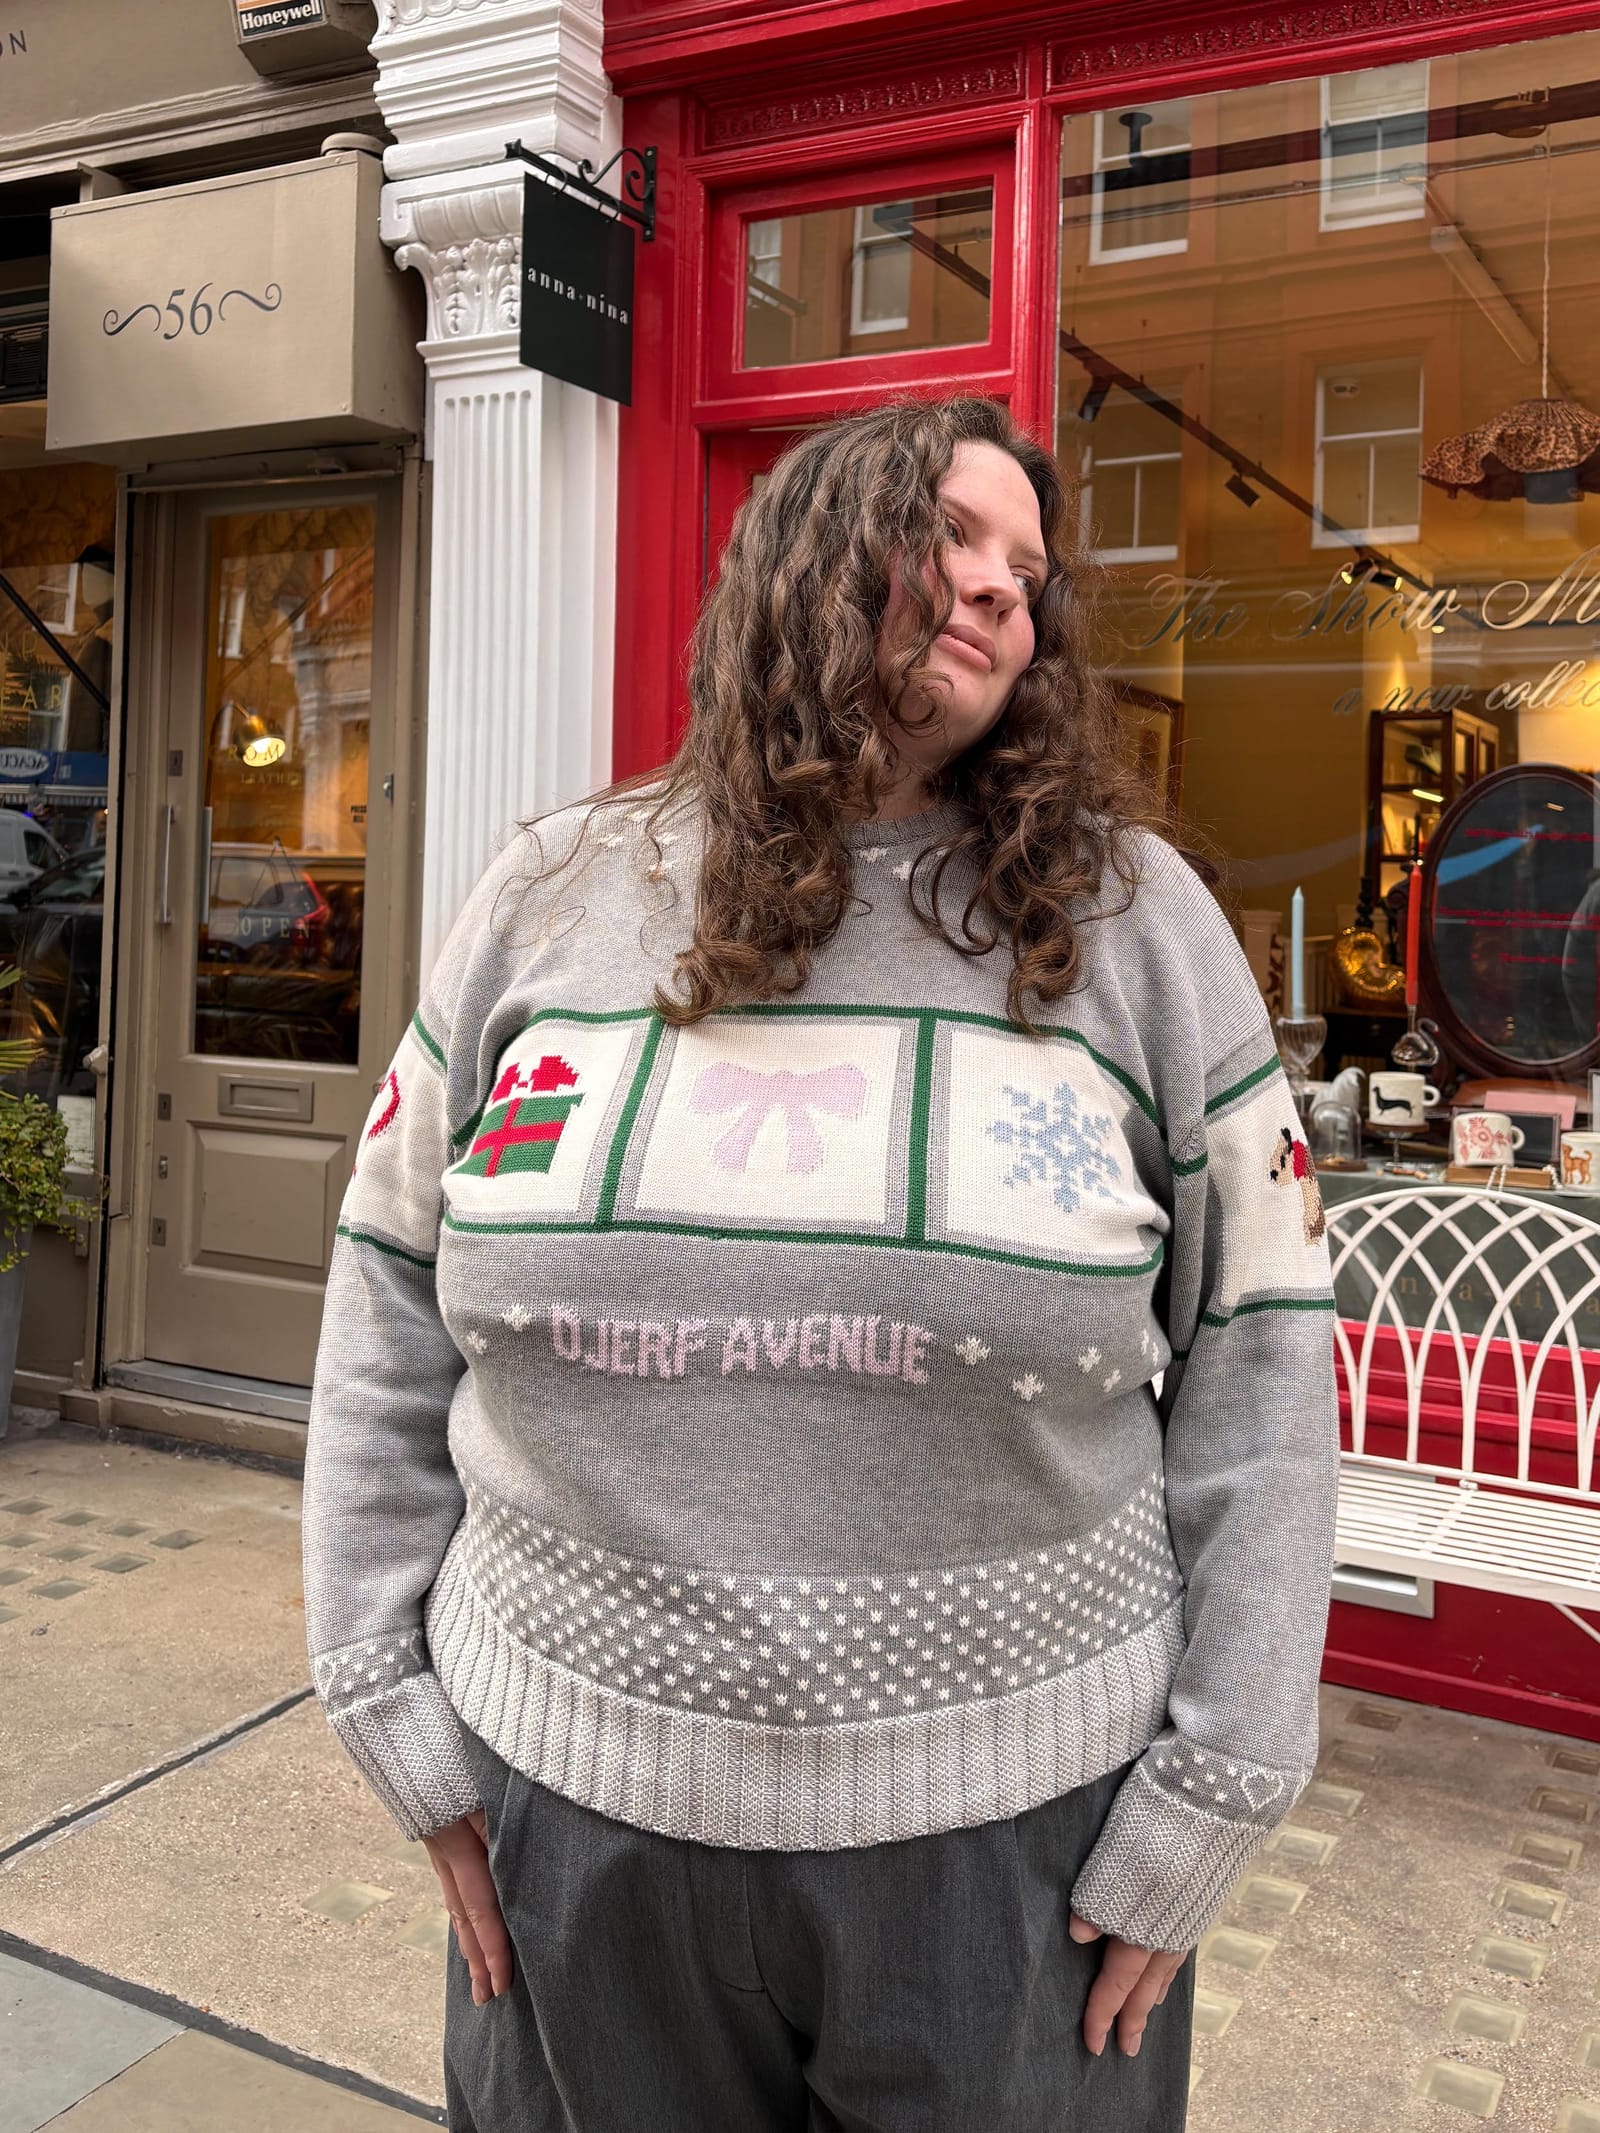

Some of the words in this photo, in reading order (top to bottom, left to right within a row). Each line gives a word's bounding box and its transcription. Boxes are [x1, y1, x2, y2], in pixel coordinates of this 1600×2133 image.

[241, 0, 321, 29] Honeywell
[0, 30, 27, 56] N
[163, 282, 214, 340] 56
[1120, 573, 1250, 650] The
[1267, 559, 1461, 642] Show
[1332, 683, 1363, 716] a
[1384, 679, 1472, 716] new
[241, 916, 310, 939] OPEN
[551, 1302, 708, 1379] DJERF
[721, 1313, 936, 1385] AVENUE
